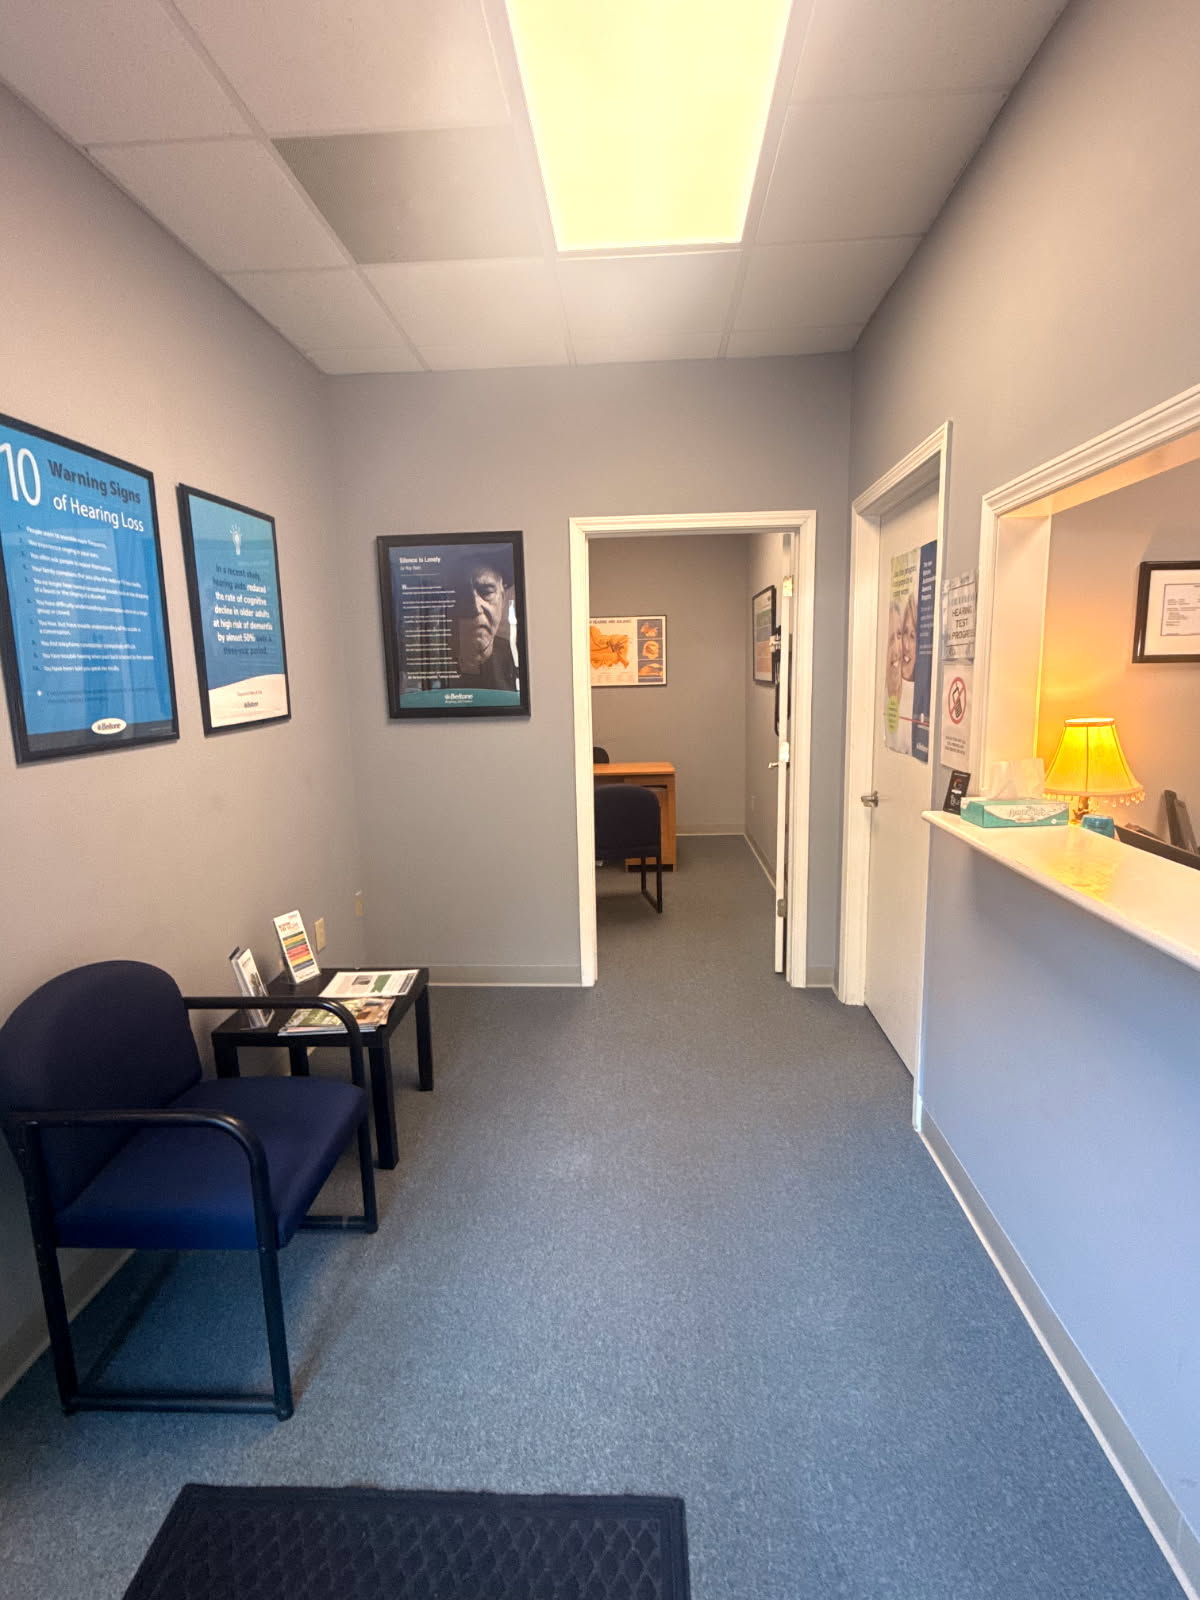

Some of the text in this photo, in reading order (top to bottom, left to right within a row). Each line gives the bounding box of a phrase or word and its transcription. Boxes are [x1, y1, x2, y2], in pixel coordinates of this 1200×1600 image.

[0, 442, 42, 507] 10
[47, 459, 141, 505] Warning Signs
[53, 494, 144, 532] of Hearing Loss
[956, 618, 969, 629] TEST
